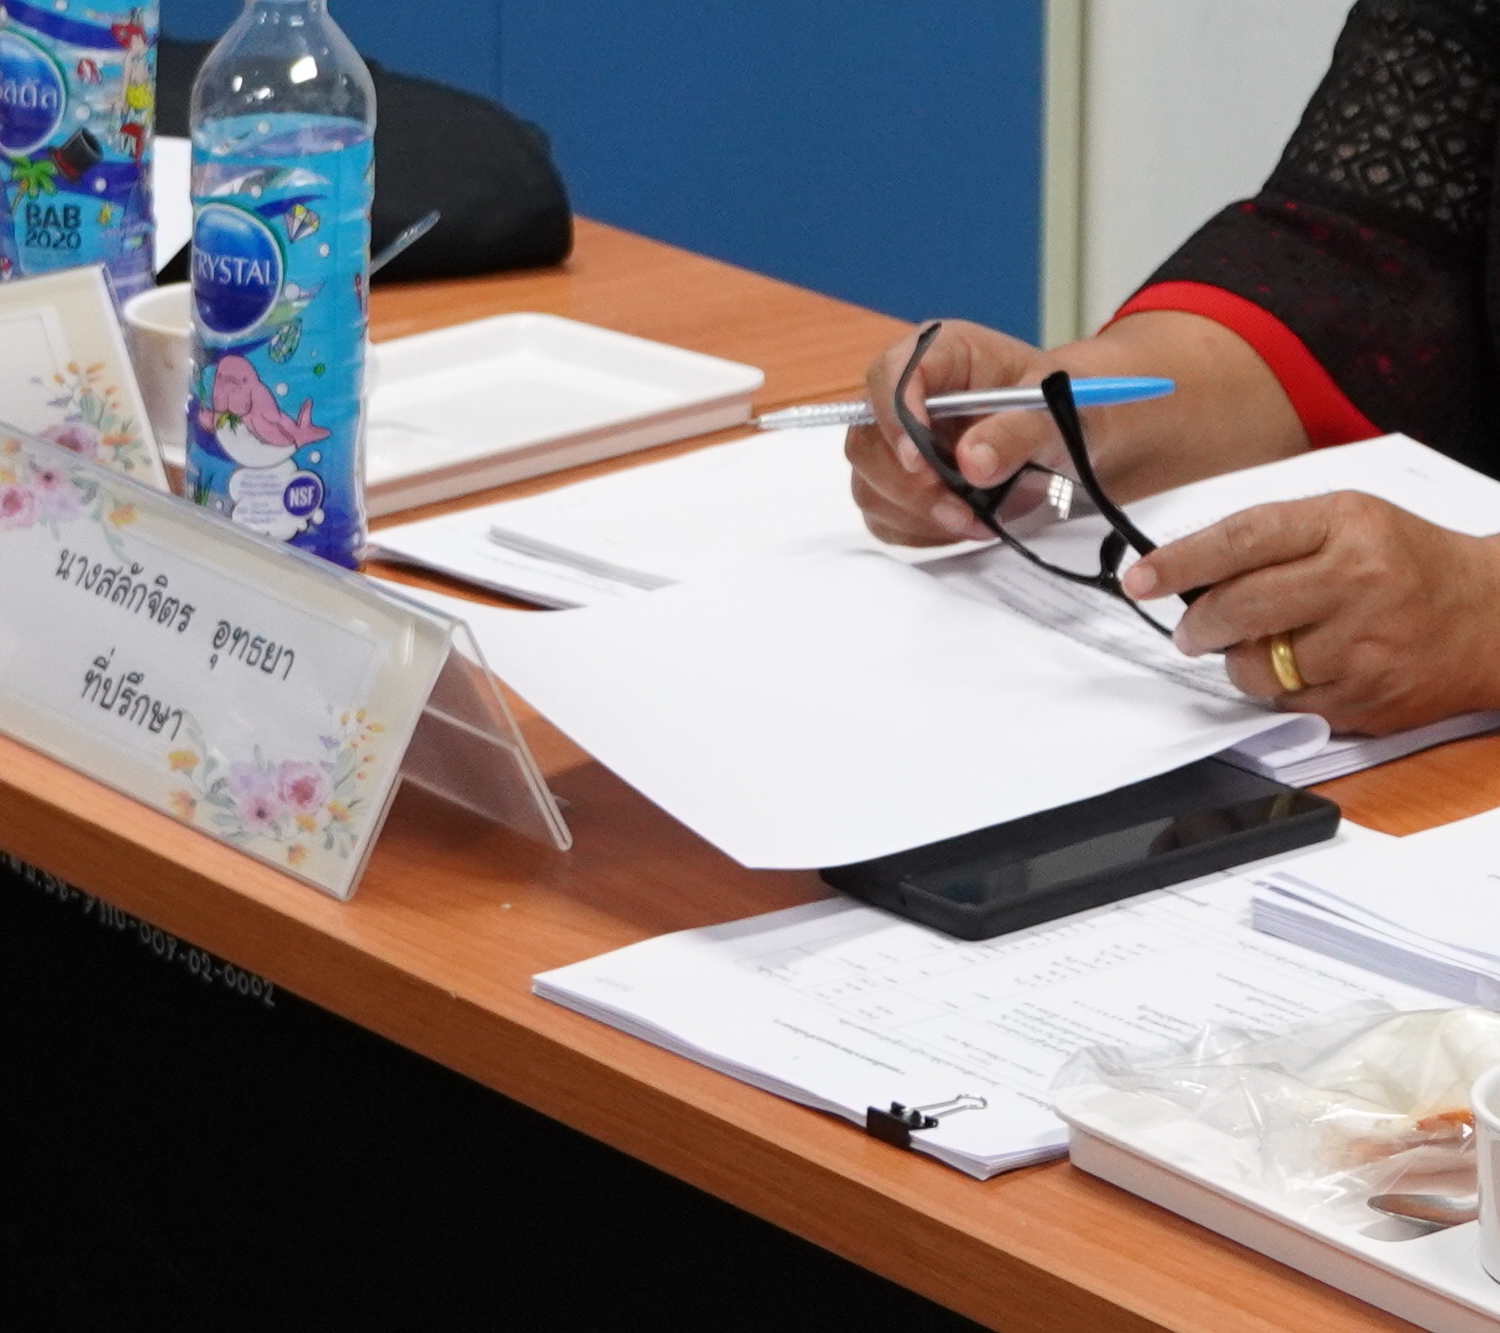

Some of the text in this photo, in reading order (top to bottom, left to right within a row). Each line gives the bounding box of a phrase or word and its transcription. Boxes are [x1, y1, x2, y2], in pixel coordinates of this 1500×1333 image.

[25, 202, 82, 230] BAB
[25, 230, 82, 250] 2020
[195, 251, 271, 286] RYSTAL
[288, 485, 315, 508] NSF
[55, 548, 295, 681] นางสลักจิตร อุทธยา
[81, 646, 183, 742] ที่ปรึกษา
